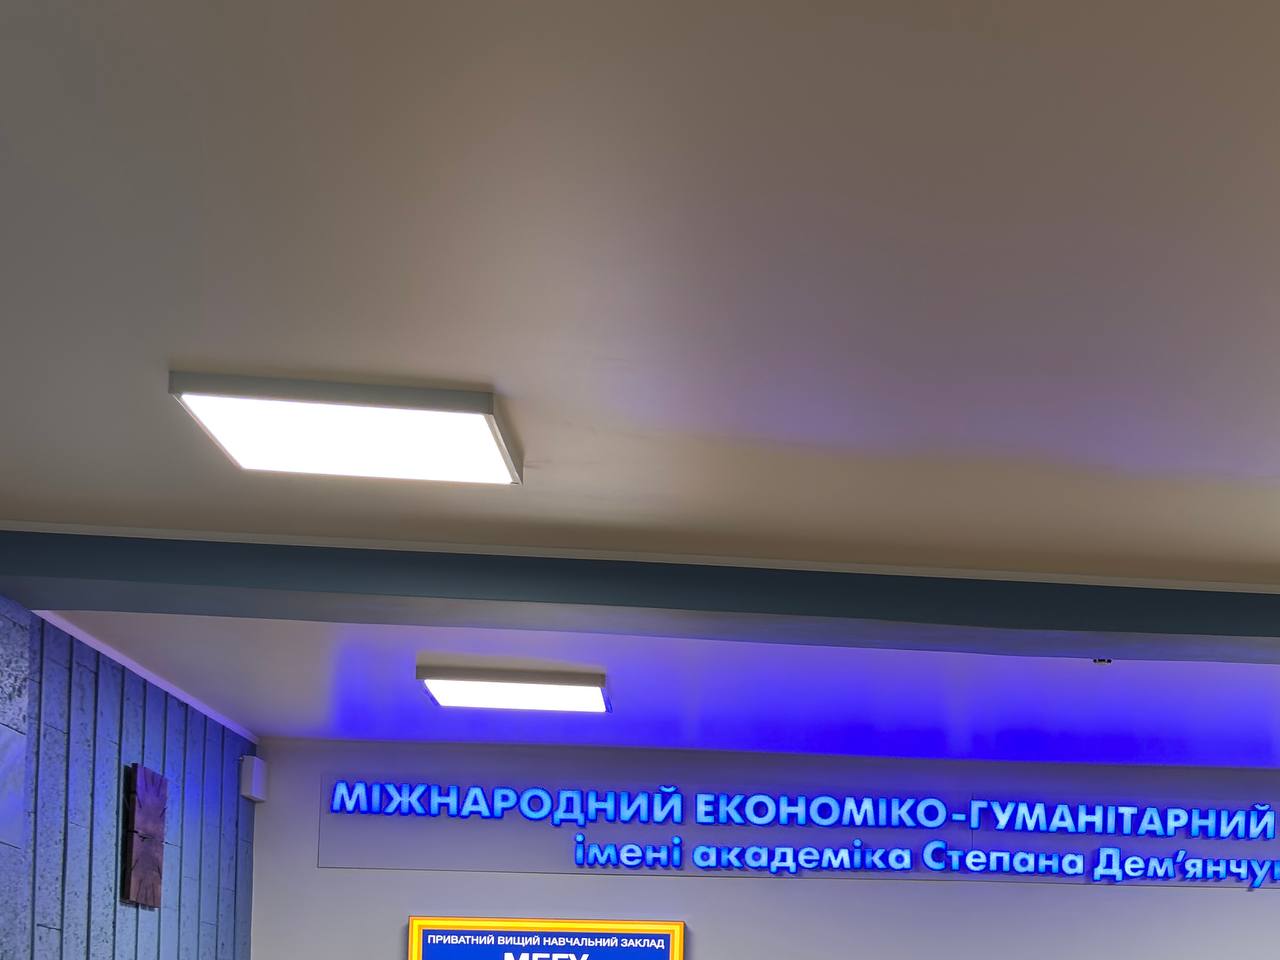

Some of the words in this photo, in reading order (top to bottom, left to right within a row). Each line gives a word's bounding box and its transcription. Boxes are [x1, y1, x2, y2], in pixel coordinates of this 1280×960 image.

[330, 780, 684, 827] МІЖНАРОДНИЙ
[696, 792, 1275, 842] ЕКОНОМІКО-ГУМАНІТАРНИЙ
[574, 832, 683, 868] імені
[693, 838, 912, 875] академіка
[922, 840, 1085, 877] Степана
[427, 934, 494, 945] ПРИВАТНИЙ
[497, 935, 540, 948] ВИЩИЙ
[543, 936, 618, 948] НАВЧАЛЬНИЙ
[620, 938, 665, 949] ЗАКЛАД
